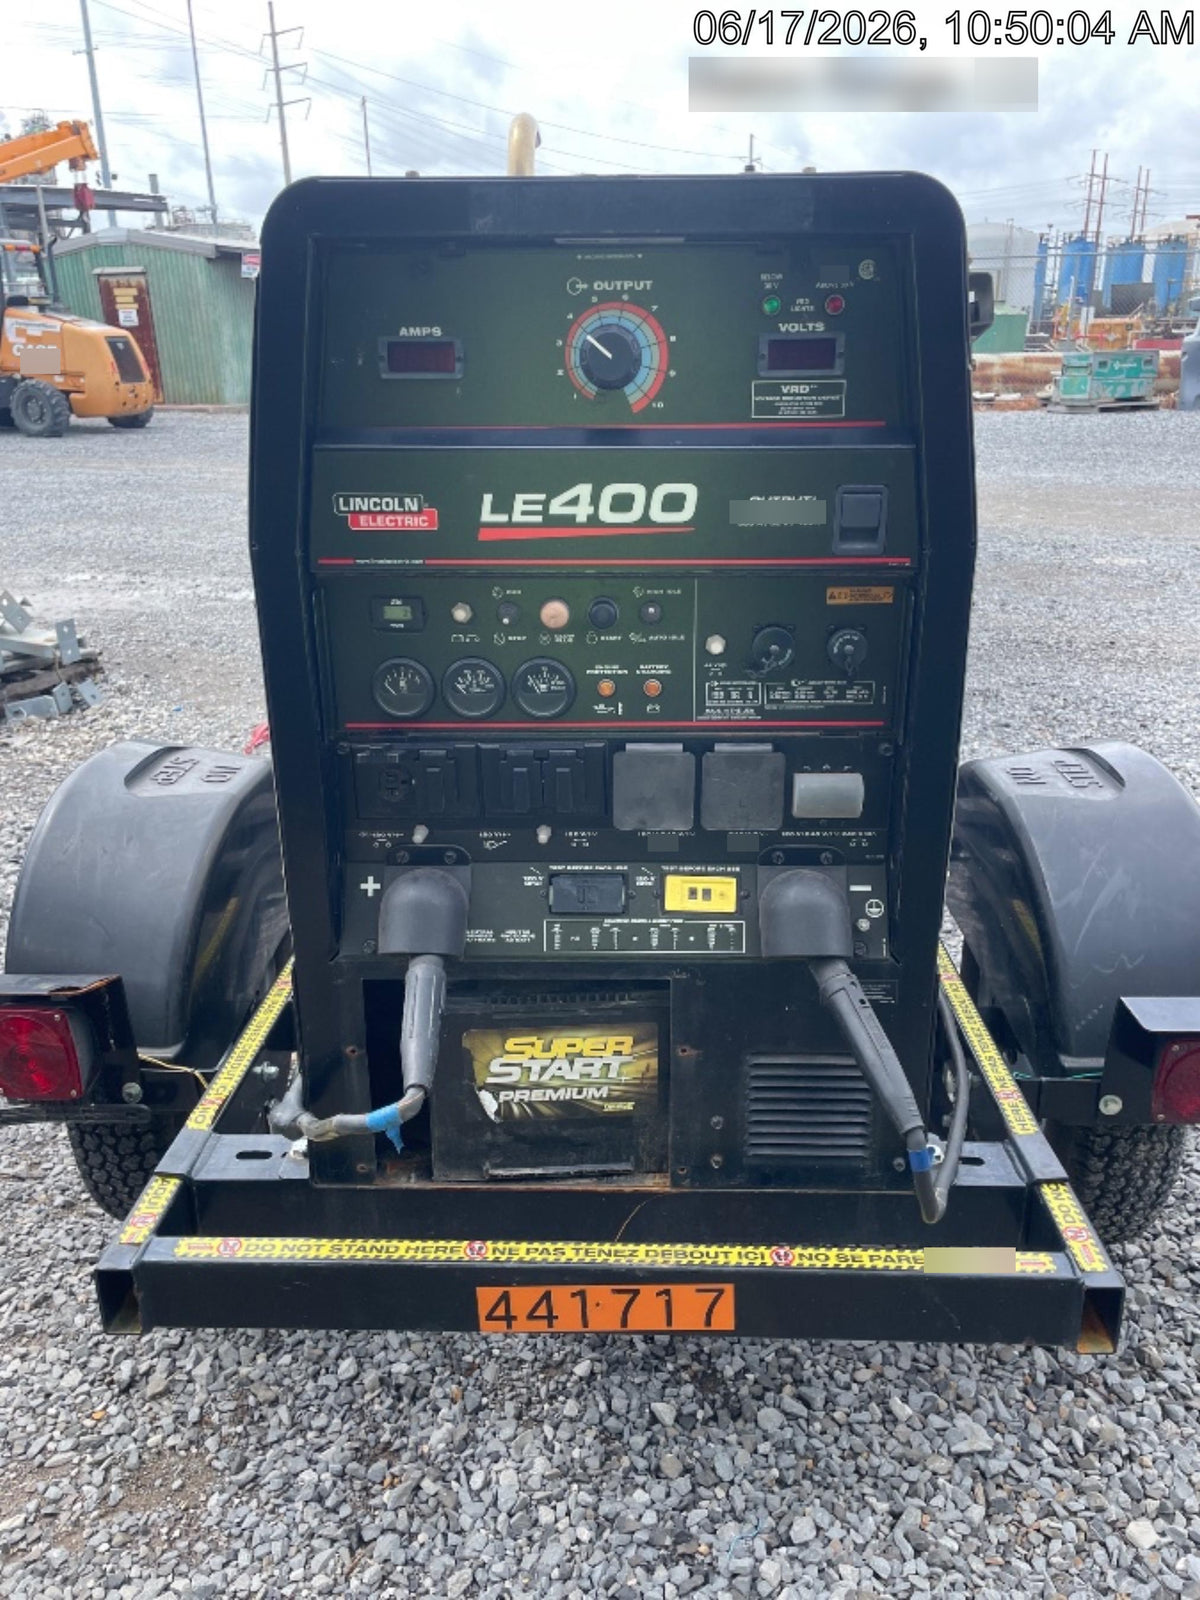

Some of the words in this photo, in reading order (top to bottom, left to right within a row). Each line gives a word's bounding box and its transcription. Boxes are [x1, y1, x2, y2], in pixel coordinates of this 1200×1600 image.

[592, 280, 654, 291] OUTPUT
[399, 327, 442, 337] AMPS
[778, 322, 826, 333] VOLTS
[338, 497, 418, 512] LINCOLN
[480, 483, 699, 523] LE400
[359, 515, 430, 528] ELECTRIC
[502, 1036, 634, 1061] SUPER
[485, 1055, 638, 1083] START
[498, 1086, 609, 1103] PREMIUM
[1046, 1182, 1067, 1200] NO
[245, 1243, 277, 1253] DO
[281, 1243, 325, 1254] NOT
[328, 1243, 398, 1255] STAND
[404, 1244, 462, 1257] HERE
[492, 1245, 520, 1256] NE
[526, 1246, 566, 1257] PAS
[571, 1246, 640, 1258] TENEZ
[645, 1247, 736, 1260] DEBOUT
[737, 1248, 766, 1261] ICI
[798, 1252, 830, 1262] NO
[838, 1252, 863, 1262] SE
